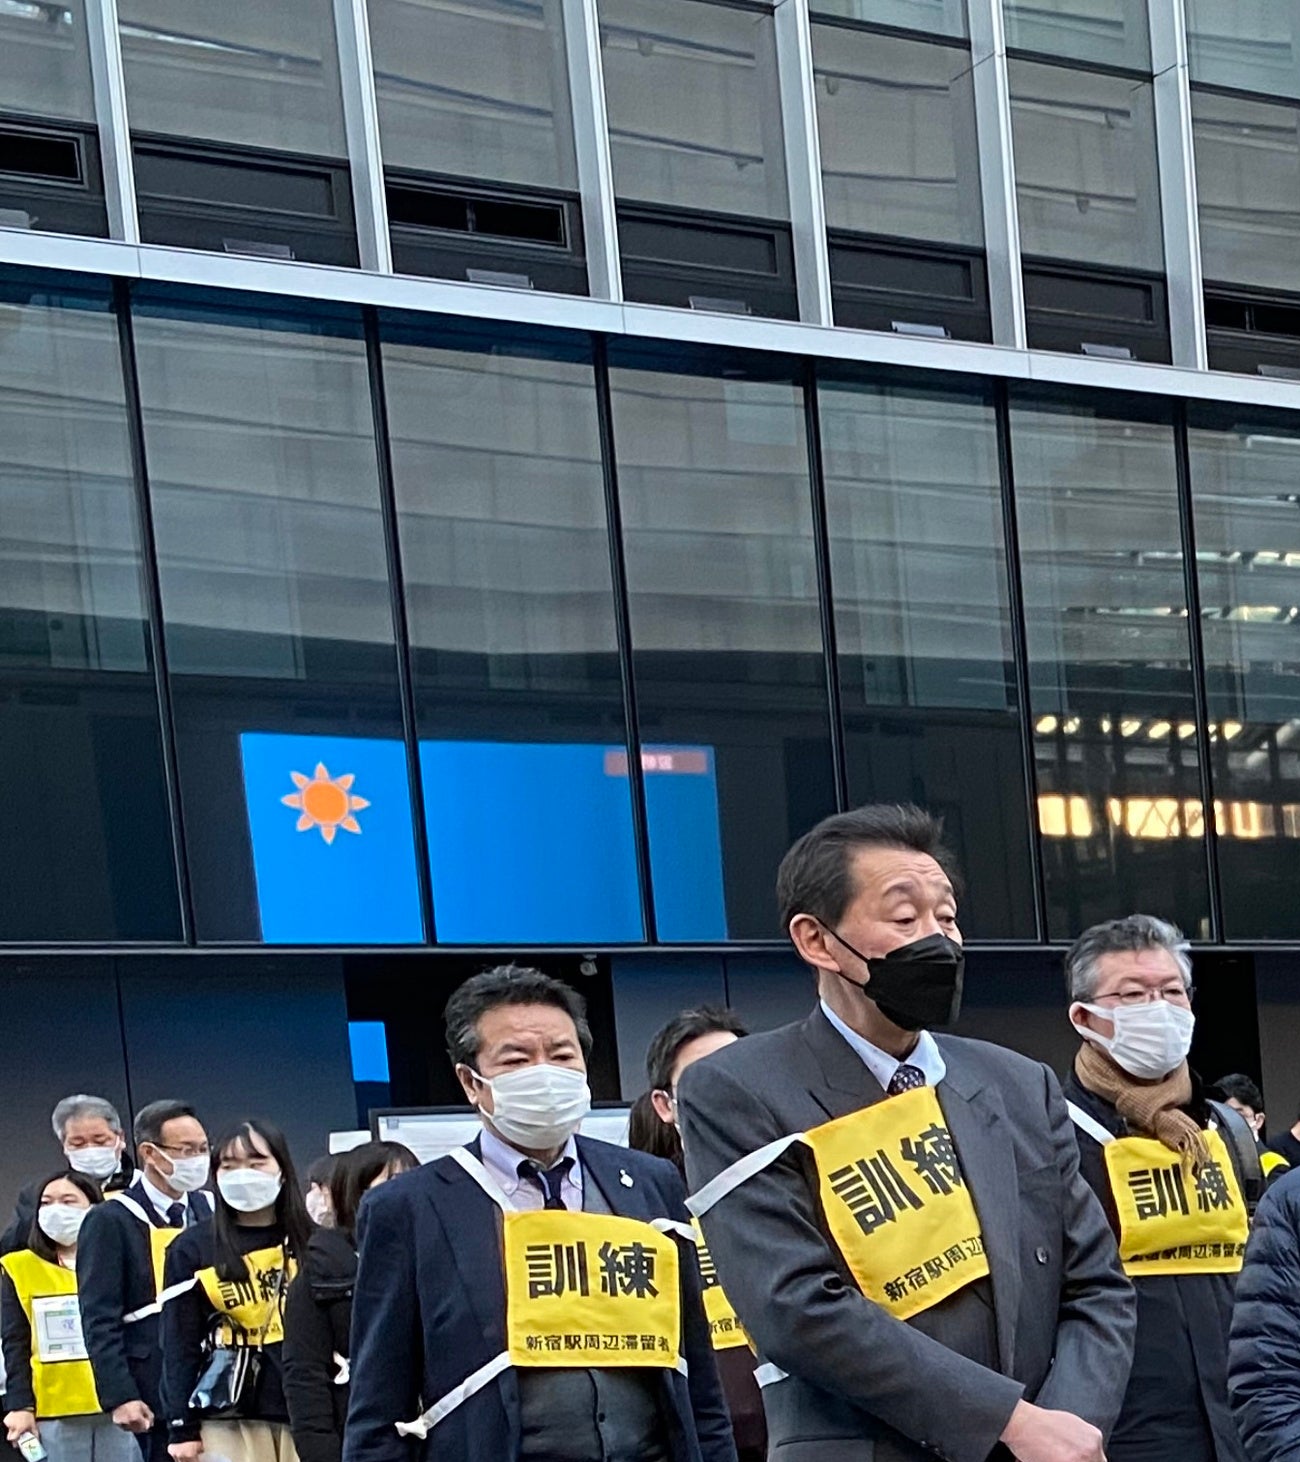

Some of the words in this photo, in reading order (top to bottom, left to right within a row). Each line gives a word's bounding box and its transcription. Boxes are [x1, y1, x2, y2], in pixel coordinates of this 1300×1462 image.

[828, 1122, 962, 1237] 訓練
[1128, 1161, 1235, 1221] 訓練
[525, 1241, 660, 1299] 訓練
[526, 1334, 670, 1353] 新宿駅周辺滞留者
